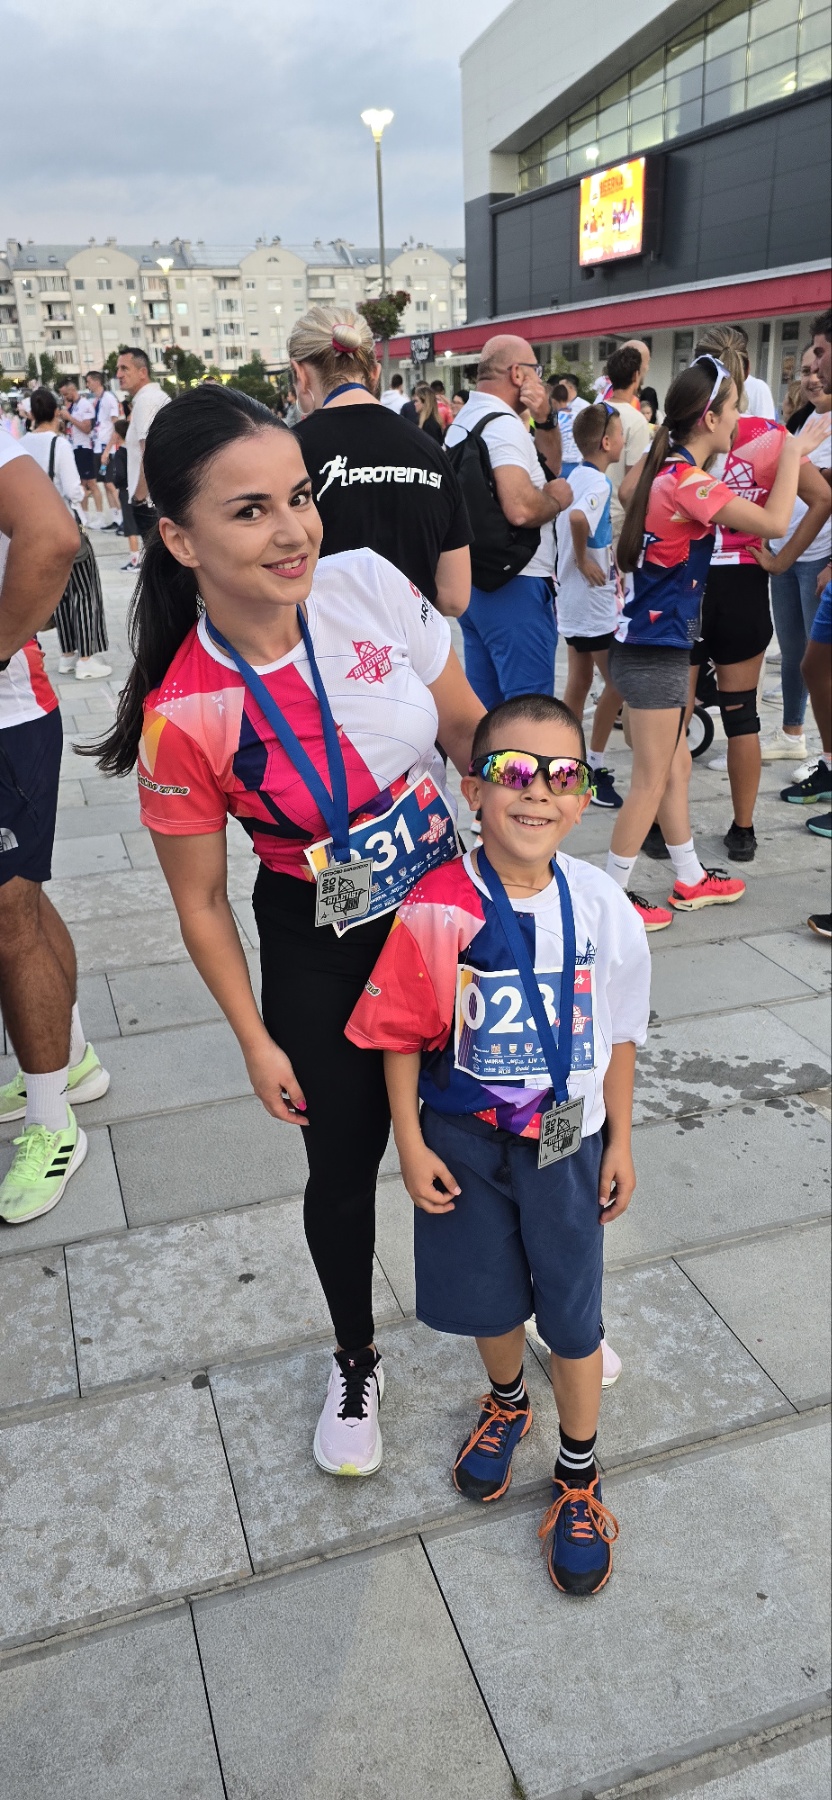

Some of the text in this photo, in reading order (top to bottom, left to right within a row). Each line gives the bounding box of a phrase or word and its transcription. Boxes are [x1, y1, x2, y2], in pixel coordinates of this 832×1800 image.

[354, 649, 387, 678] ATLETIST
[378, 659, 391, 675] 5K
[322, 877, 336, 887] 20
[322, 885, 335, 894] 25
[545, 1118, 557, 1128] 20
[544, 1126, 555, 1137] 25
